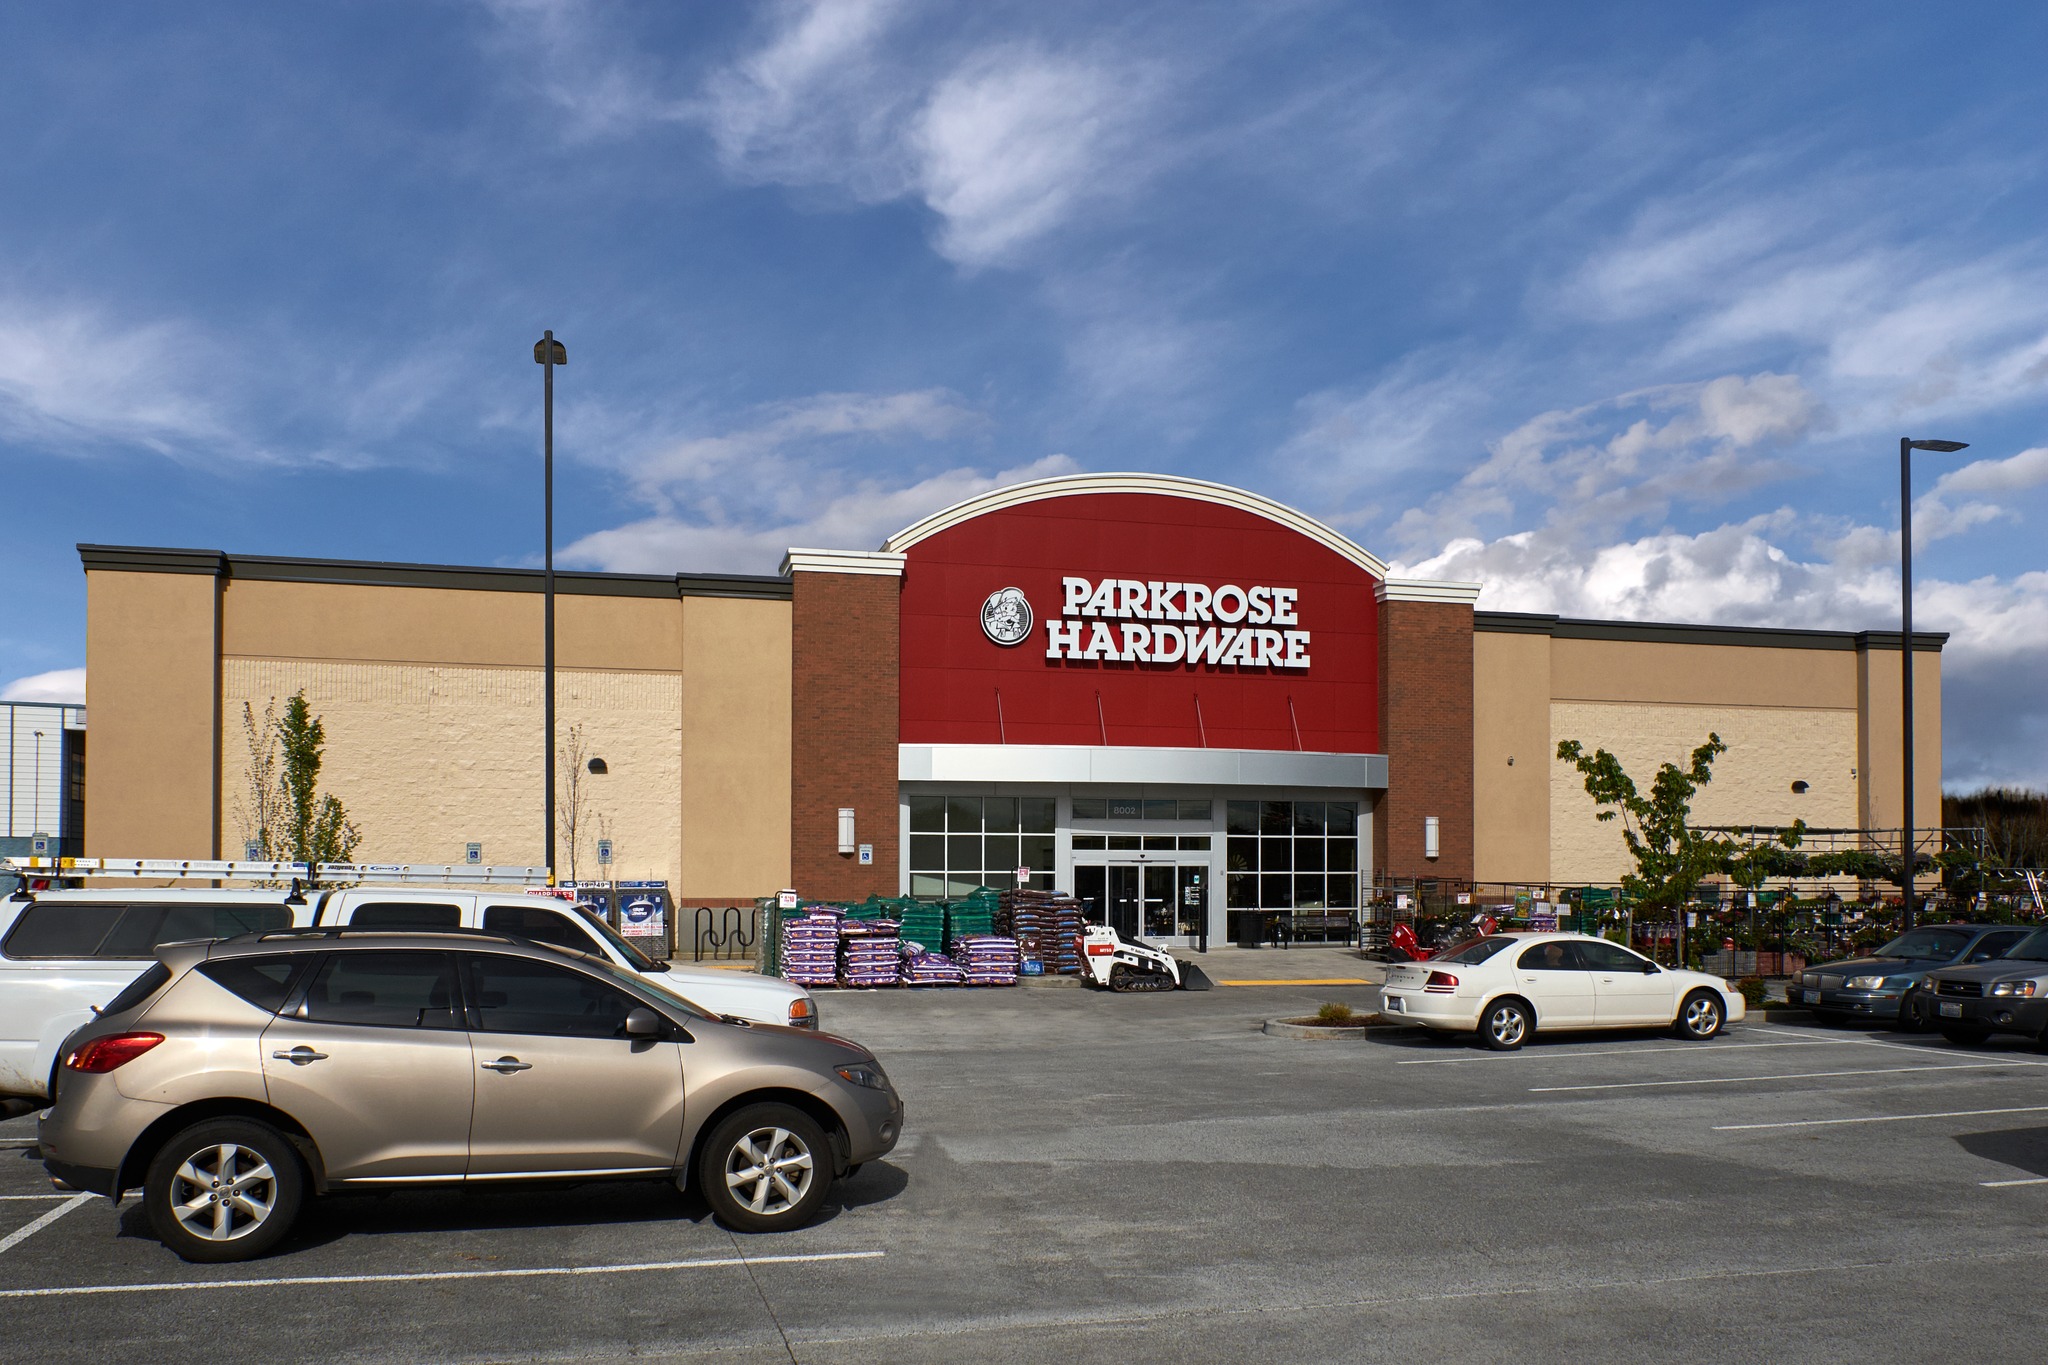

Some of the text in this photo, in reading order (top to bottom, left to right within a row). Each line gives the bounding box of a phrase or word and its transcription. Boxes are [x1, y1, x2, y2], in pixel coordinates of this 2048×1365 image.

[1062, 576, 1298, 625] PARKROSE
[1046, 619, 1311, 668] HARDWARE
[1113, 806, 1136, 815] 8002
